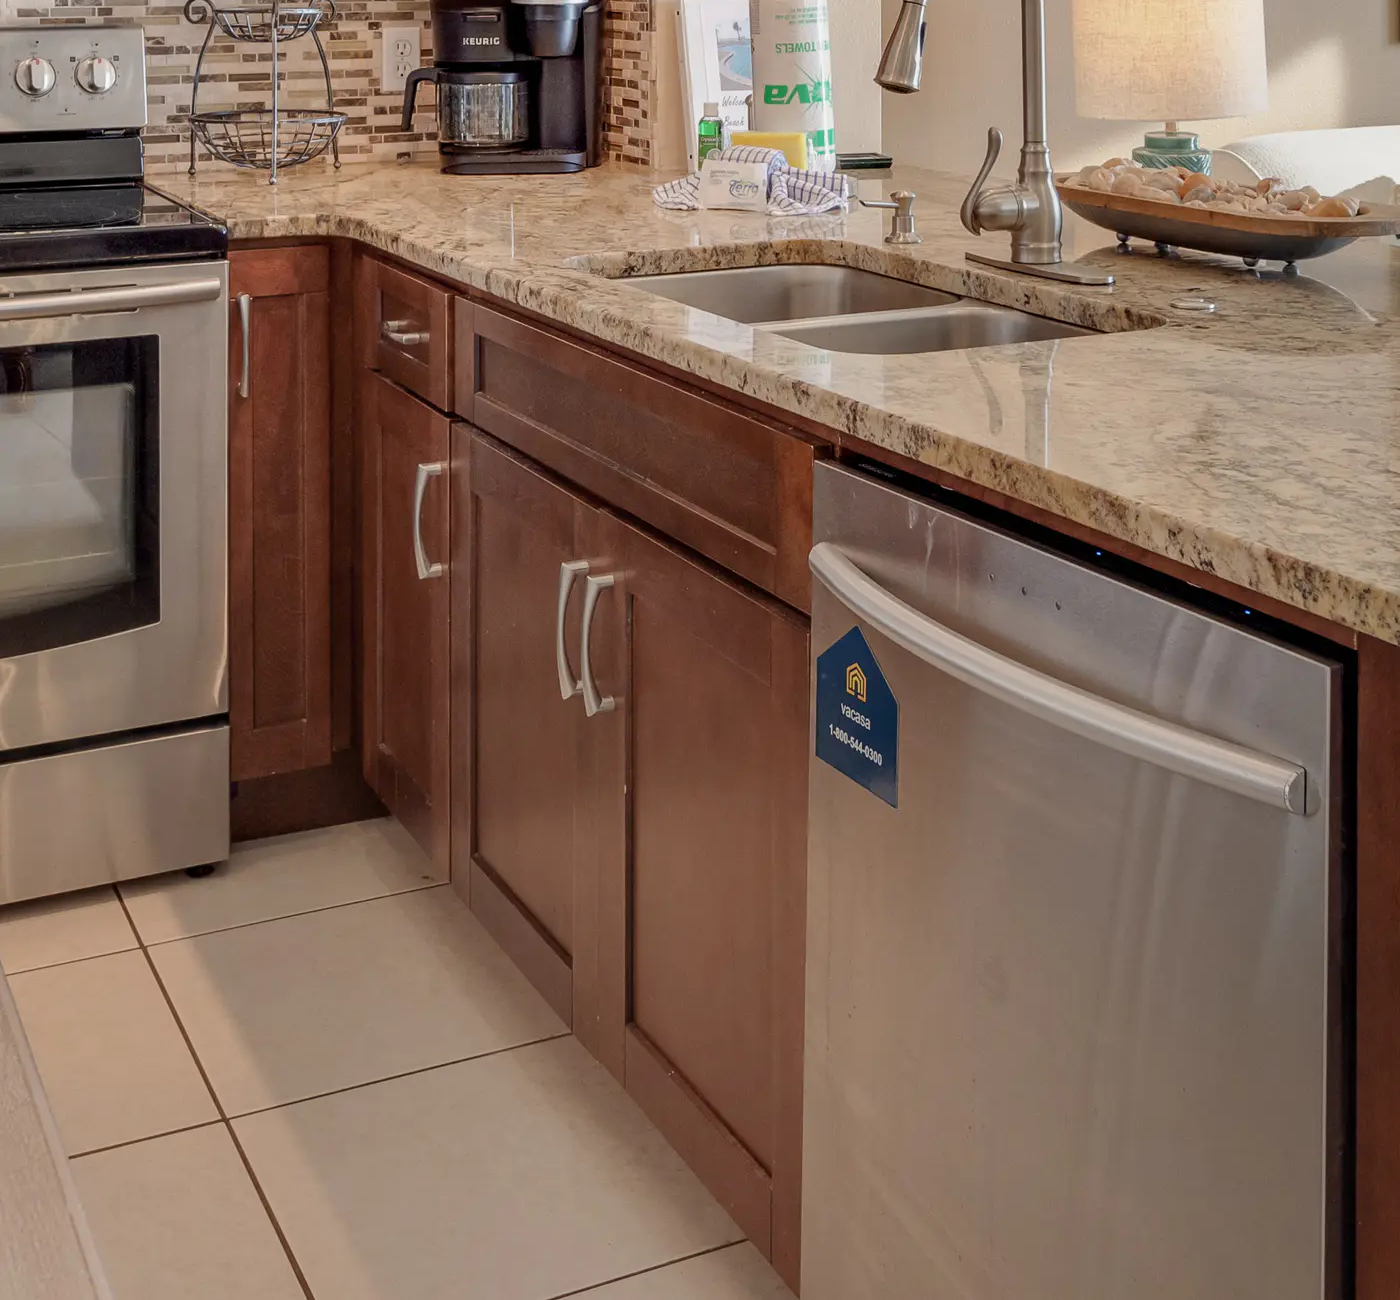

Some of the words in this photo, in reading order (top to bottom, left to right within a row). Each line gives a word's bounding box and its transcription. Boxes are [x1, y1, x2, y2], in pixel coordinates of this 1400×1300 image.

[462, 36, 500, 46] KEURIG
[775, 41, 817, 54] TOWELS
[722, 95, 746, 107] Welco
[723, 115, 745, 127] Beach
[840, 702, 871, 731] vacasa
[829, 723, 883, 767] 1-800-544-0300
